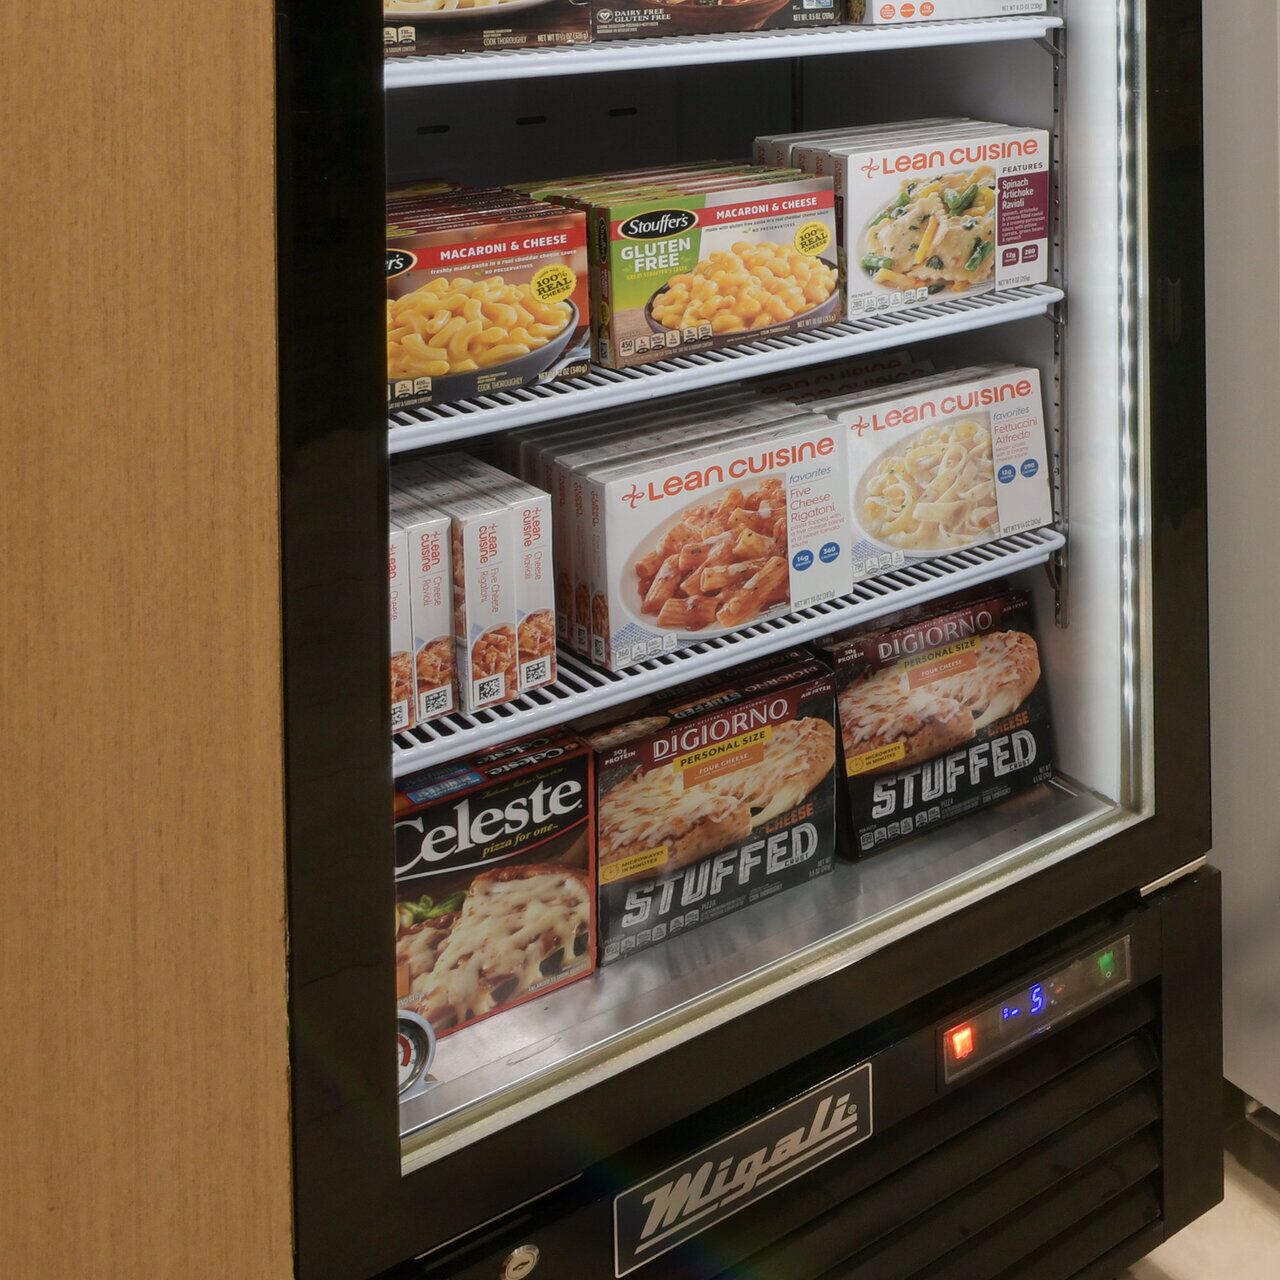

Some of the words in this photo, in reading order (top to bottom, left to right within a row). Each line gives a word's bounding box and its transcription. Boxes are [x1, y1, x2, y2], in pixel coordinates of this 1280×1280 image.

[1002, 162, 1043, 173] FEATURES
[1002, 178, 1029, 189] Spinach
[1002, 187, 1034, 200] Artichoke
[716, 203, 769, 219] MACARONI
[772, 201, 779, 211] &
[782, 197, 817, 210] CHEESE
[1002, 197, 1024, 209] Ravioli
[628, 213, 688, 234] Stouffer's
[441, 243, 506, 260] MACARONI
[511, 241, 519, 250] &
[523, 234, 567, 248] CHEESE
[621, 238, 690, 260] GLUTEN
[799, 233, 828, 248] REAL
[804, 241, 827, 253] CHEESE
[634, 254, 679, 272] FREE
[537, 270, 567, 286] 100%
[536, 279, 572, 296] REAL
[542, 286, 571, 299] CHEESE
[993, 407, 1030, 420] favorites
[994, 419, 1038, 433] Fettuccini
[995, 431, 1030, 443] Alfredo
[790, 467, 832, 484] favorites
[790, 487, 811, 498] Five
[790, 493, 831, 511] Cheese
[791, 504, 835, 523] Rigatoni
[905, 649, 954, 669] PERSONAL
[956, 639, 976, 654] SIZE
[680, 738, 738, 768] PERSONAL
[741, 730, 766, 748] SIZE
[872, 729, 1036, 818] STUFFED
[395, 780, 582, 872] Celeste
[482, 840, 512, 858] pizza
[515, 833, 531, 846] for
[533, 824, 552, 838] one
[621, 824, 818, 928] STUFFED
[640, 1093, 857, 1242] Migali
